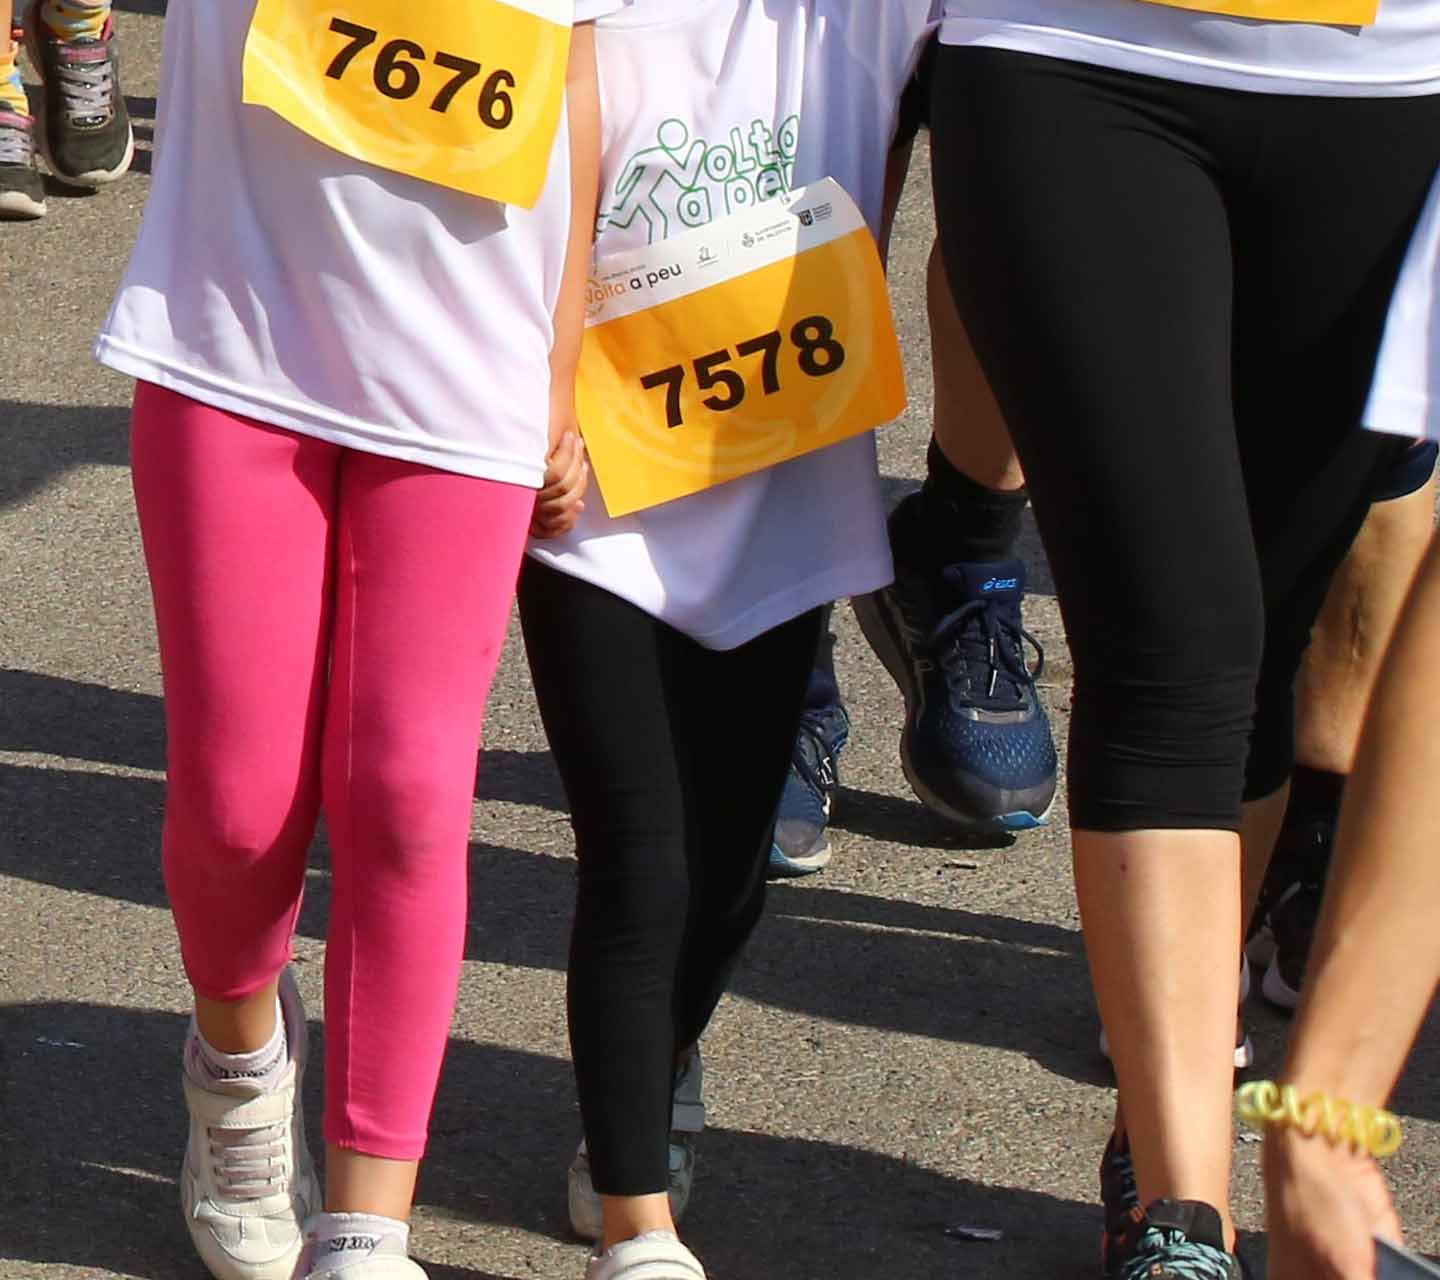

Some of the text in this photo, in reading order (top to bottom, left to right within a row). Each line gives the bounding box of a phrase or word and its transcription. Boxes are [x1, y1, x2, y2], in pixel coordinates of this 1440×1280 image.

[323, 15, 518, 132] 7676
[665, 115, 800, 189] Volta
[678, 185, 712, 228] a
[628, 274, 643, 292] a
[645, 262, 683, 290] peu
[641, 314, 847, 429] 7578
